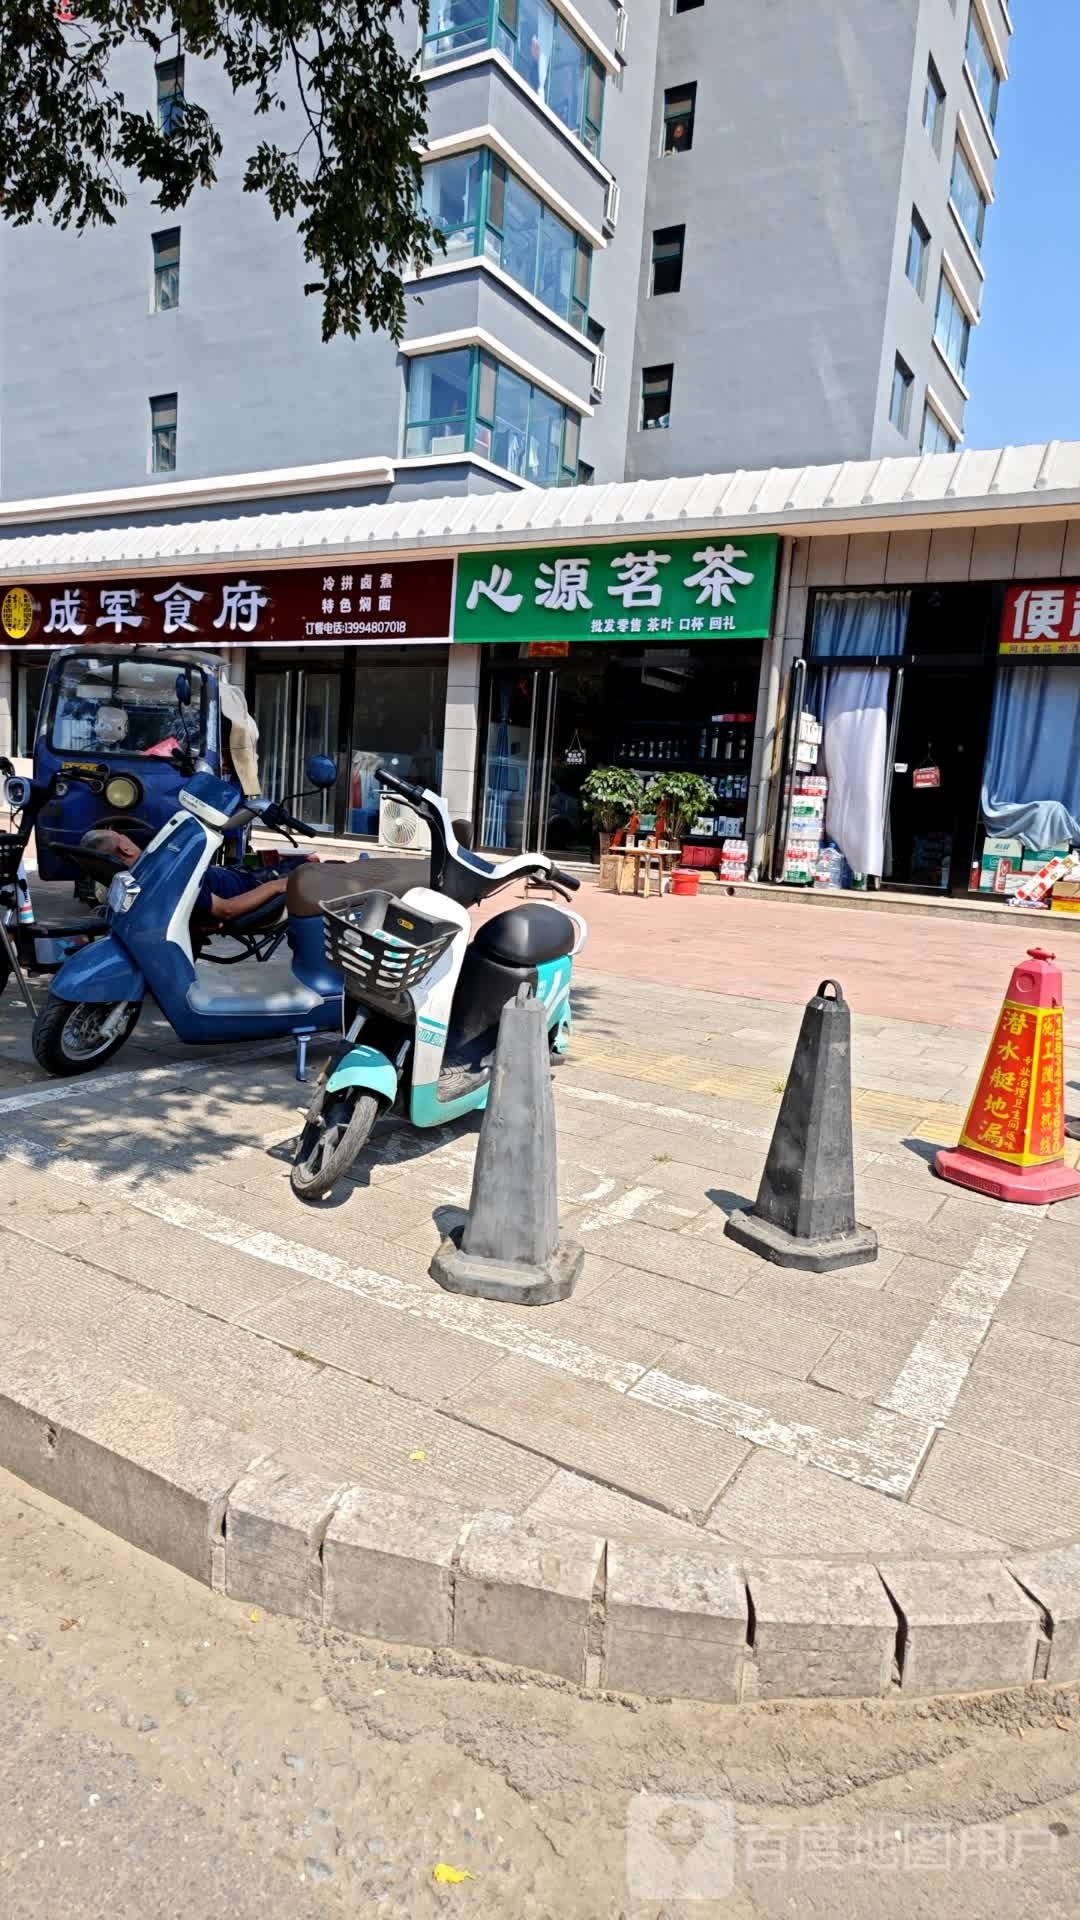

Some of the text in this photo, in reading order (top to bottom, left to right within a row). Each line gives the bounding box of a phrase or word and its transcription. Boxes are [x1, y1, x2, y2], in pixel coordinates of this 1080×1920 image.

[322, 572, 393, 591] 冷拼卤煮
[466, 543, 755, 613] 心源茗茶
[43, 580, 268, 634] 成军食府
[321, 595, 392, 614] 特色焖面
[591, 615, 736, 632] 批发零售 茶叶 口杯 回礼
[1012, 588, 1080, 640] 便
[978, 1010, 1029, 1148] 潜水艇地漏
